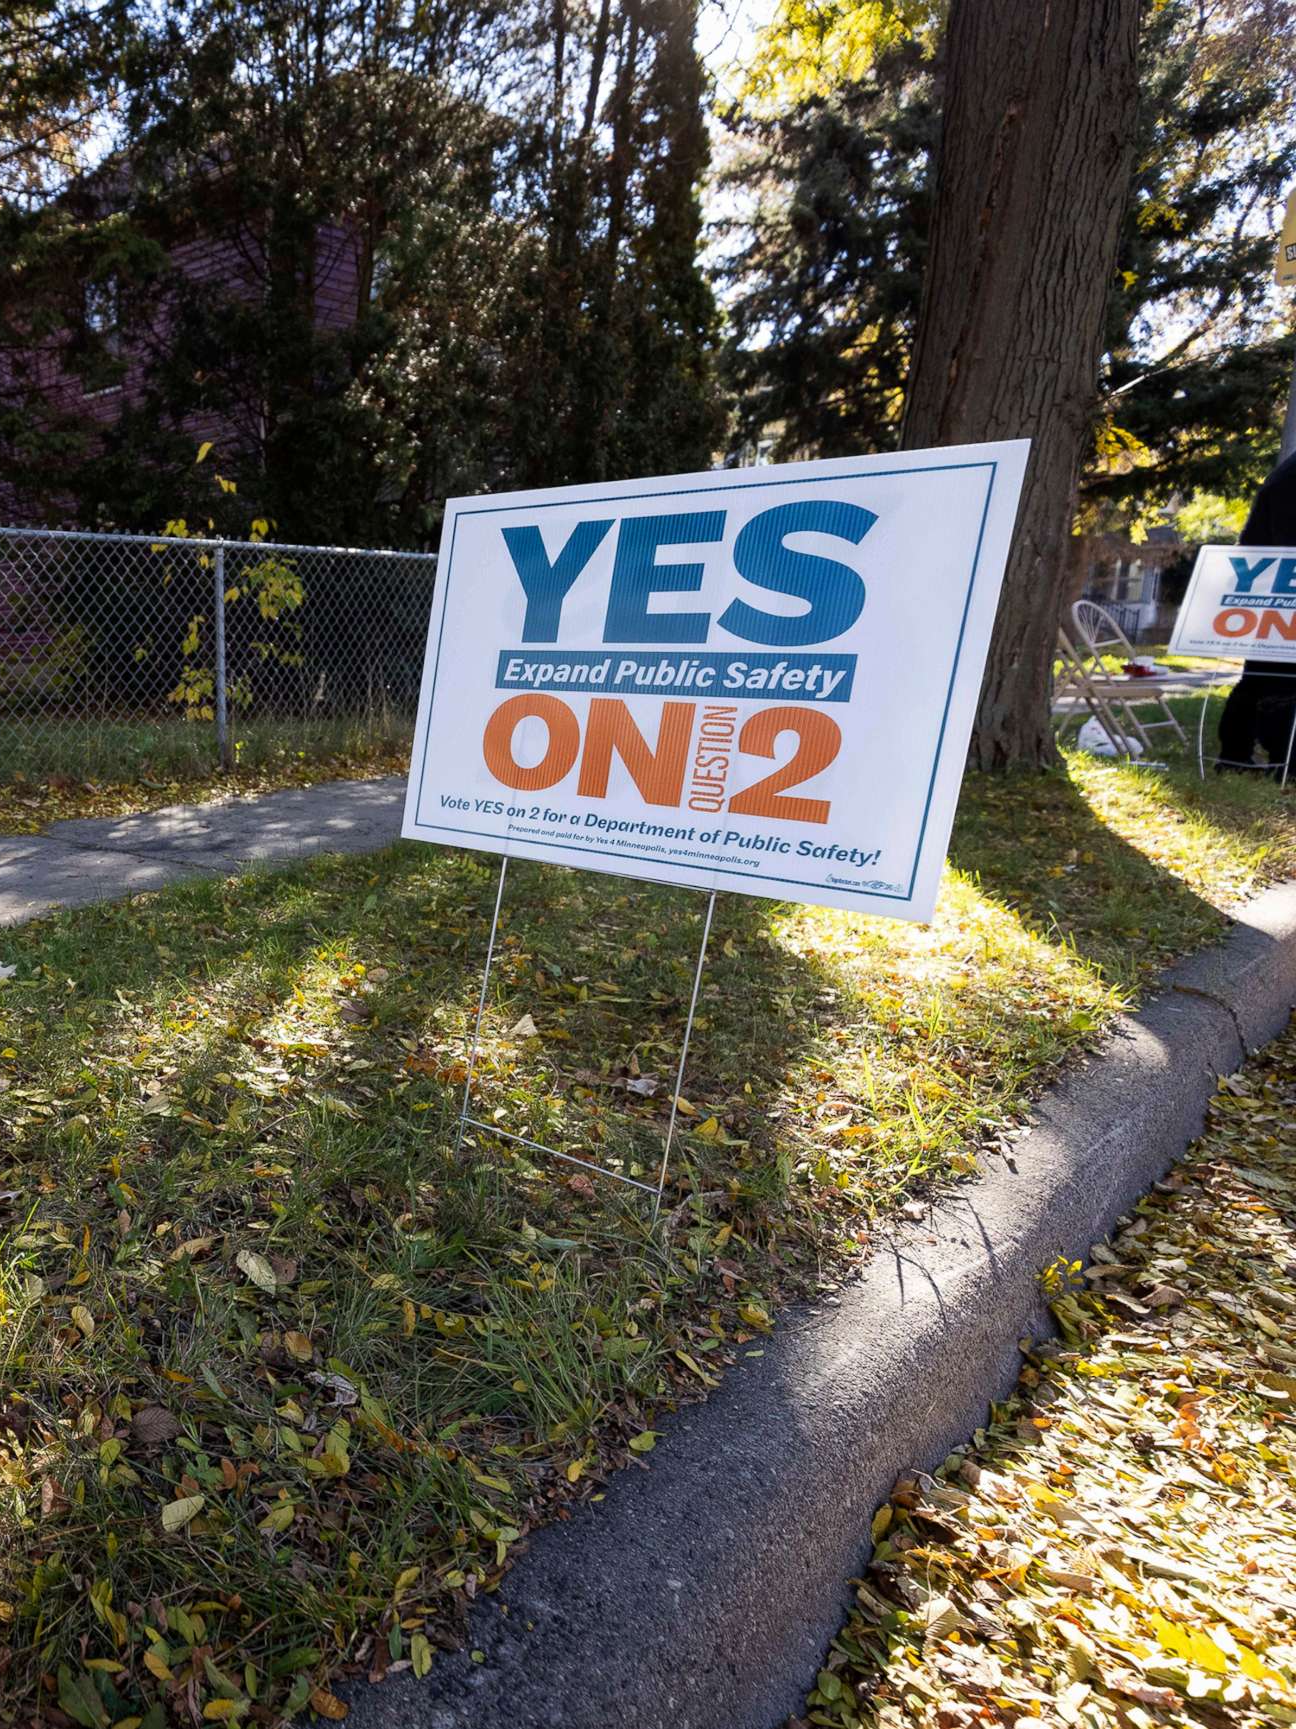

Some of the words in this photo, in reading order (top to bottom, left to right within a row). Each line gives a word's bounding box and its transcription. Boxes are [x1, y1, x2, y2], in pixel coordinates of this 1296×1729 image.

[500, 500, 880, 647] YES
[504, 658, 609, 687] Expand
[614, 660, 716, 688] Public
[722, 662, 848, 699] Safety
[483, 693, 697, 808] ON
[688, 704, 738, 813] QUESTION
[728, 706, 842, 825] 2
[440, 795, 470, 811] Vote
[474, 799, 505, 815] YES
[507, 805, 526, 818] on
[528, 806, 541, 820] 2
[543, 808, 567, 823] for
[570, 815, 581, 826] a
[584, 813, 695, 841] Department
[699, 829, 722, 844] of
[723, 831, 791, 854] Public
[796, 840, 882, 867] Safety!
[508, 824, 540, 835] Prepared
[541, 829, 554, 837] and
[555, 831, 572, 840] paid
[573, 833, 584, 841] for
[585, 835, 594, 843] by
[596, 837, 608, 845] Yes
[616, 840, 667, 854] Minneapolis,
[668, 848, 760, 868] yes4minneapolis.org
